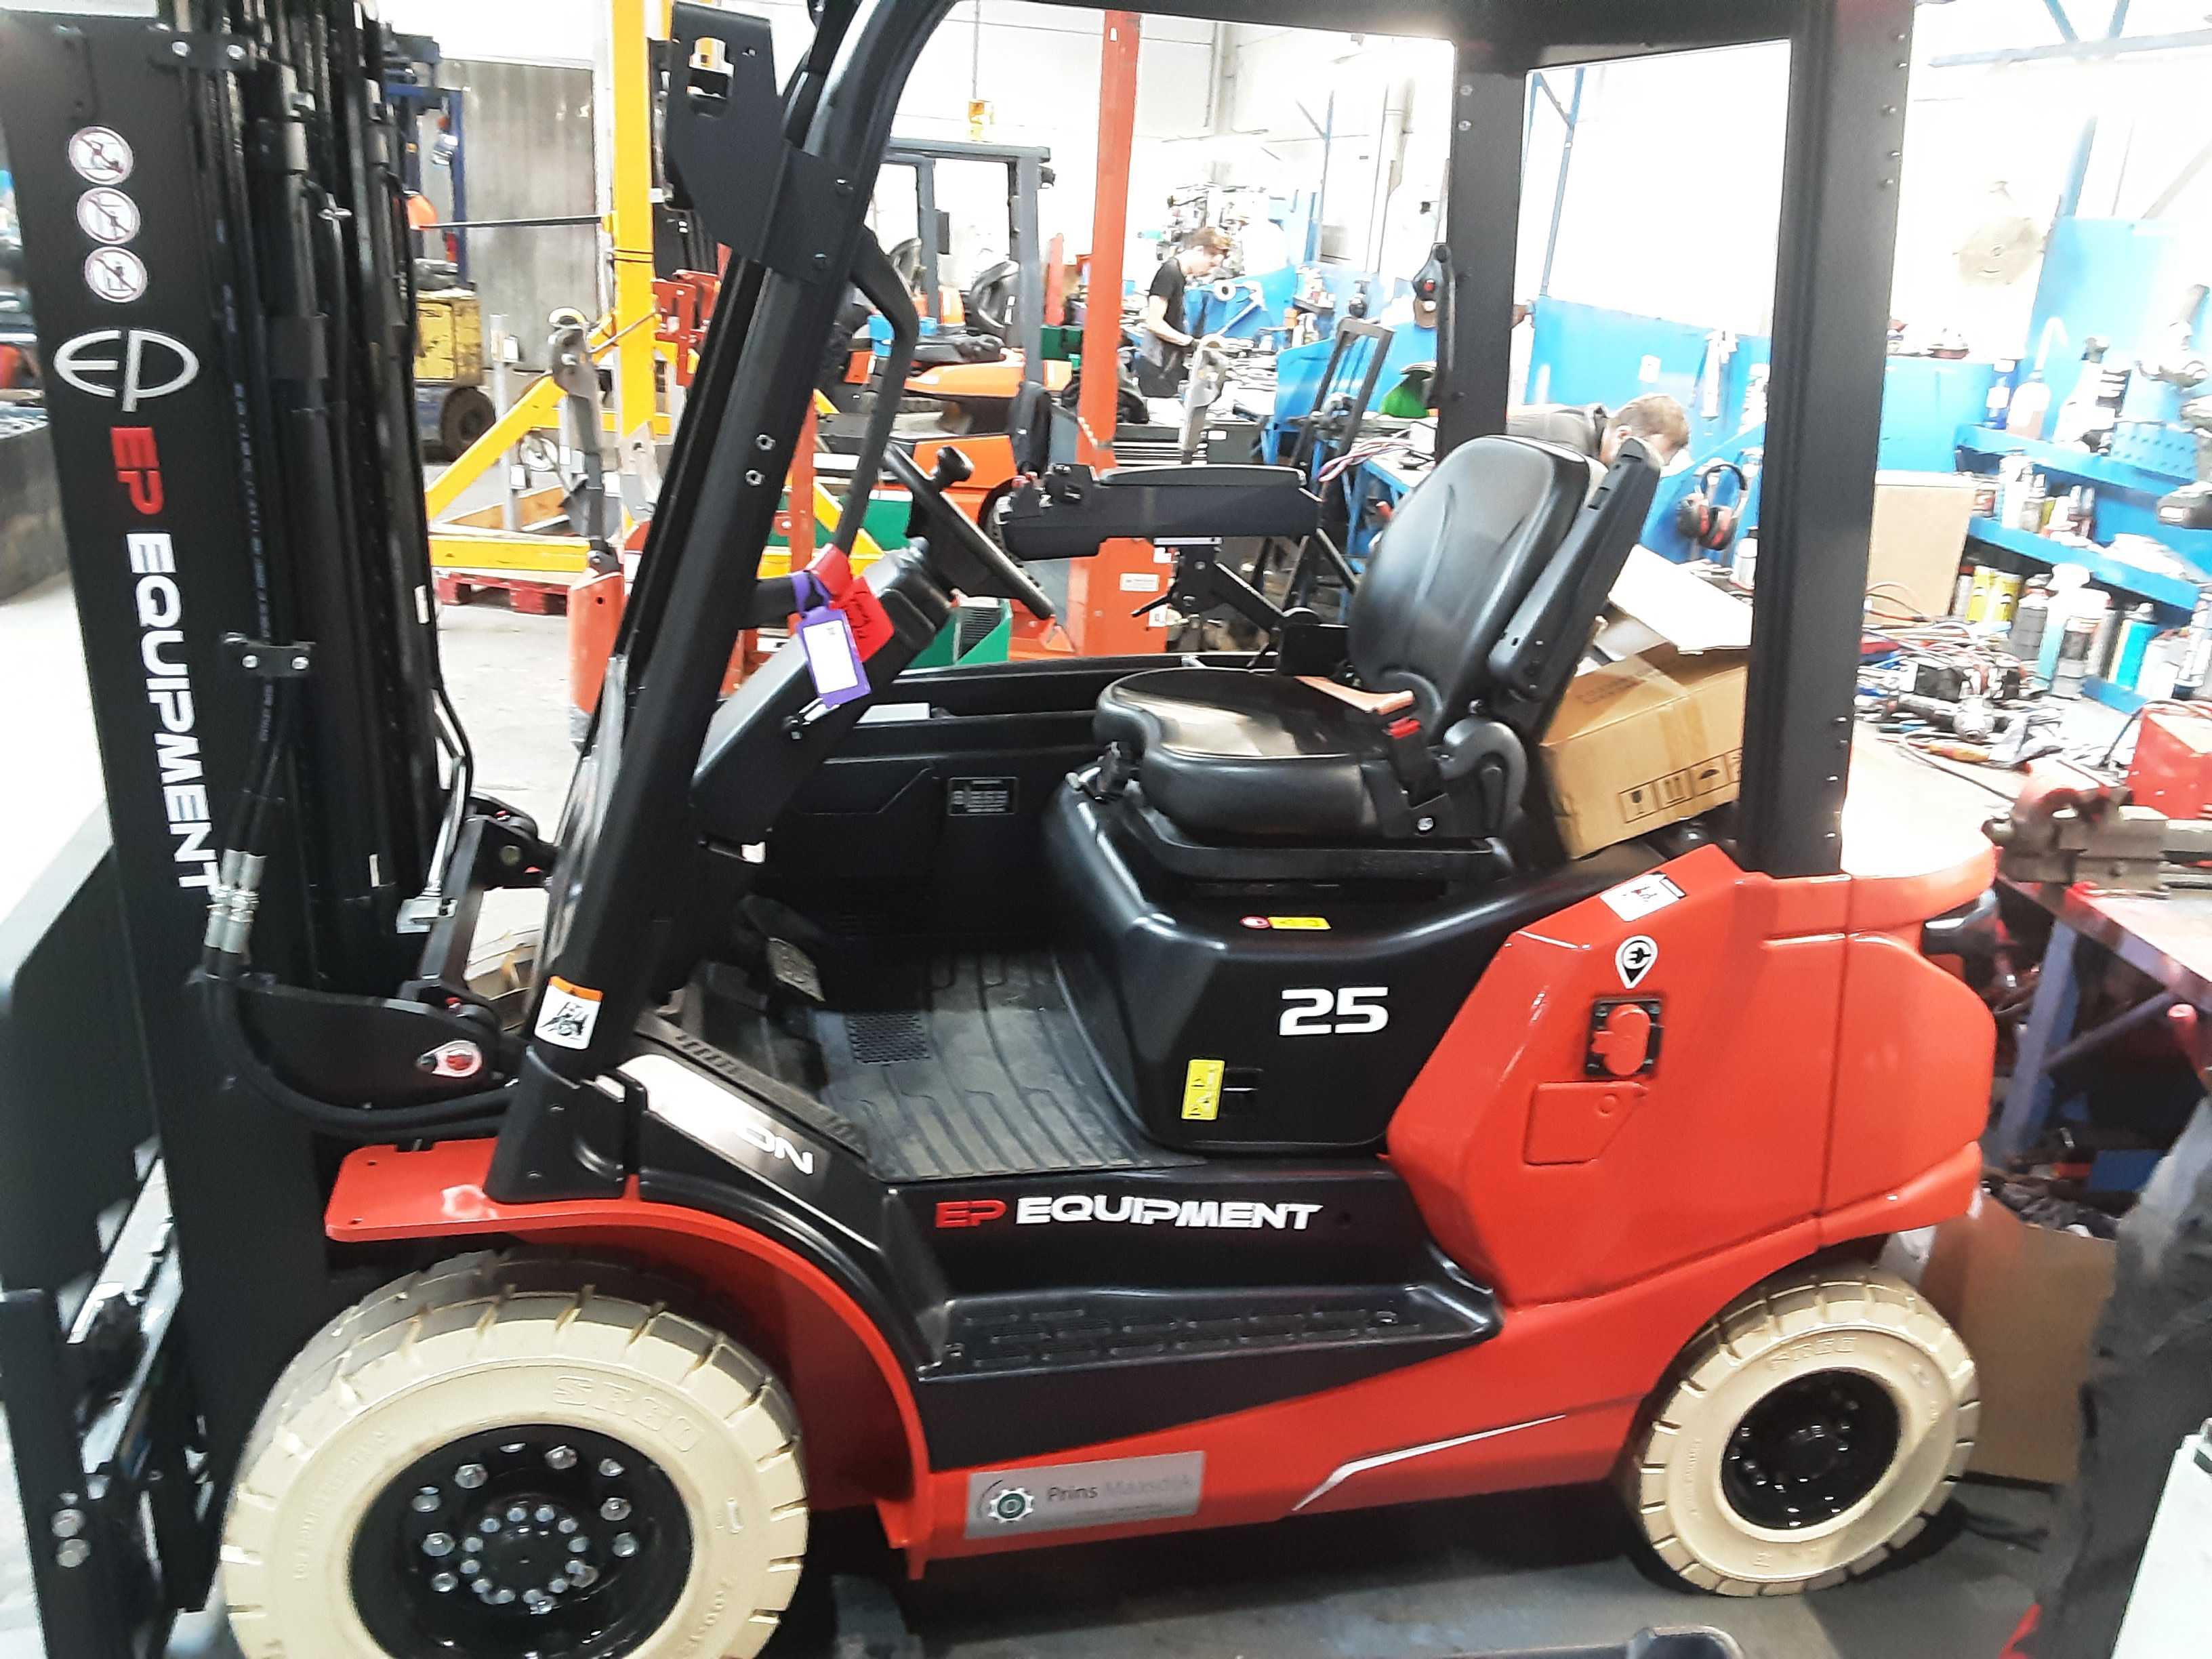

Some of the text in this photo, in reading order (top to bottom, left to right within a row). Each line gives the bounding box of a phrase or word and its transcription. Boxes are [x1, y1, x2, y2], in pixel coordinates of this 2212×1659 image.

[110, 427, 222, 896] EP EQUIPMENT
[1279, 986, 1389, 1036] 25
[935, 1194, 1324, 1230] EP EQUIPMENT
[1047, 1485, 1099, 1502] Prins
